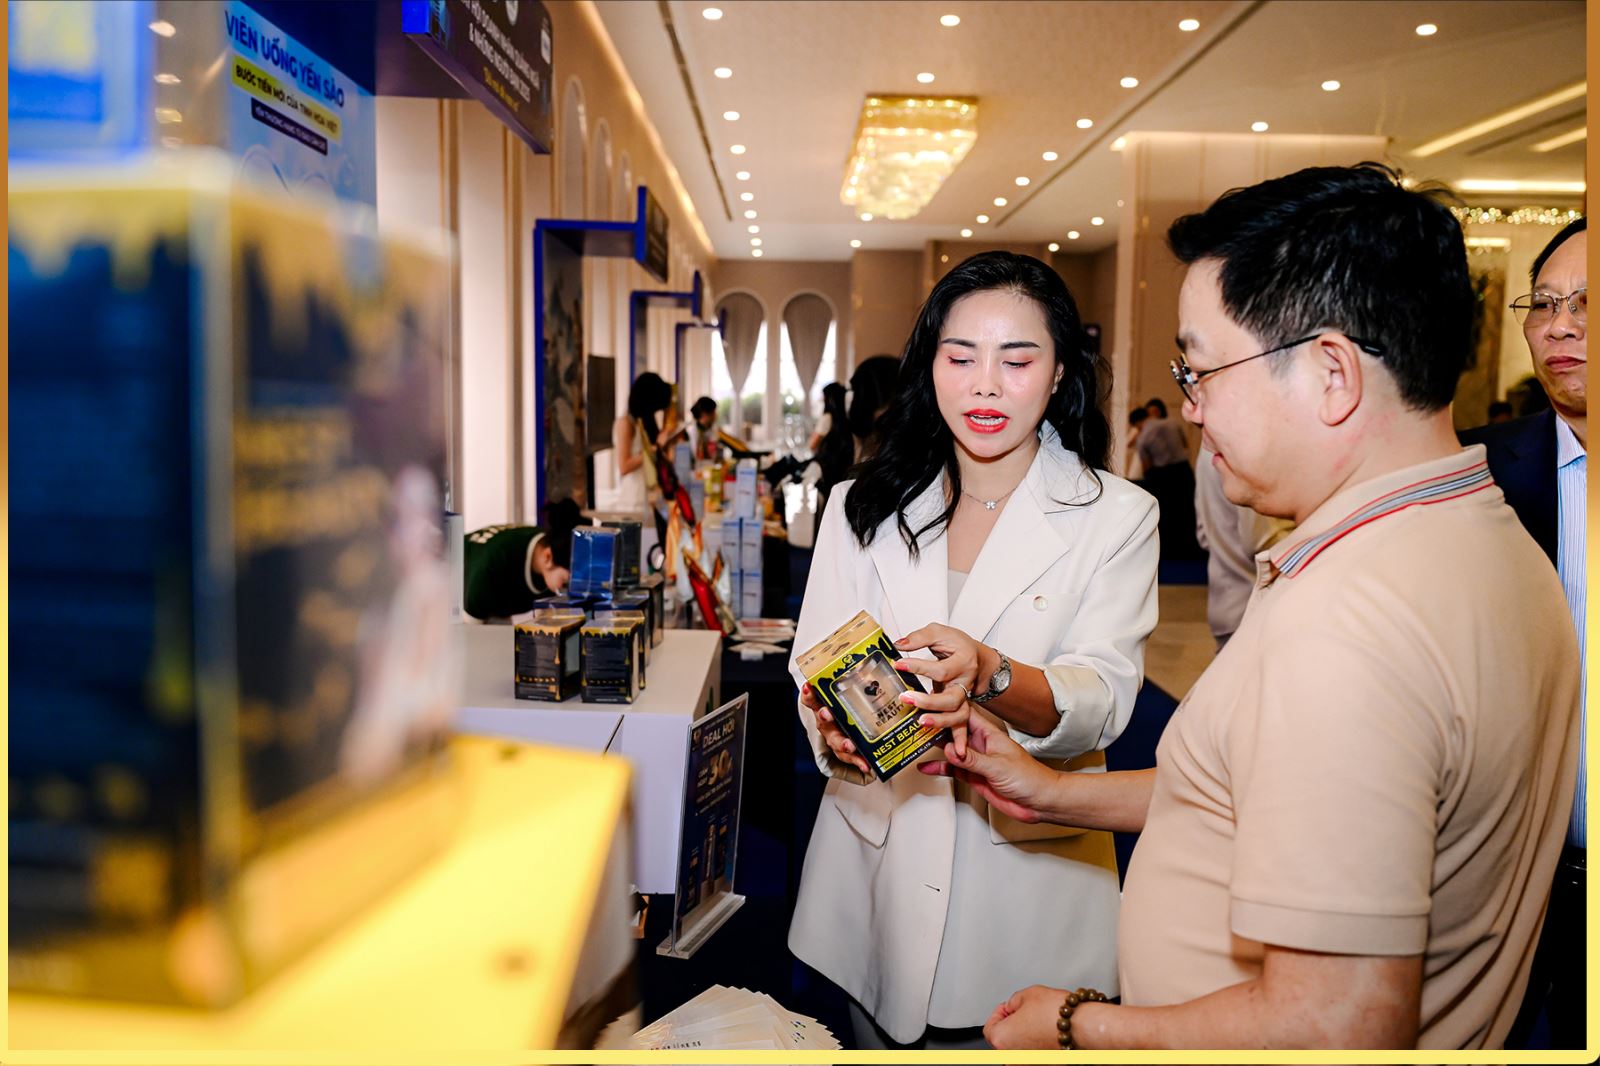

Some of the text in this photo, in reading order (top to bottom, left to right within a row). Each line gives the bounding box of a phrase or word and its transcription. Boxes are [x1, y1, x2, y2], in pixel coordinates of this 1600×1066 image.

[224, 10, 344, 108] VIÊN UỐNG YẾN SÀO
[236, 65, 256, 86] BƯỚC
[876, 704, 904, 727] BEAUTY
[877, 701, 897, 720] NEST
[703, 729, 721, 749] DEAL
[873, 738, 897, 759] NEST
[896, 719, 921, 742] BEAU
